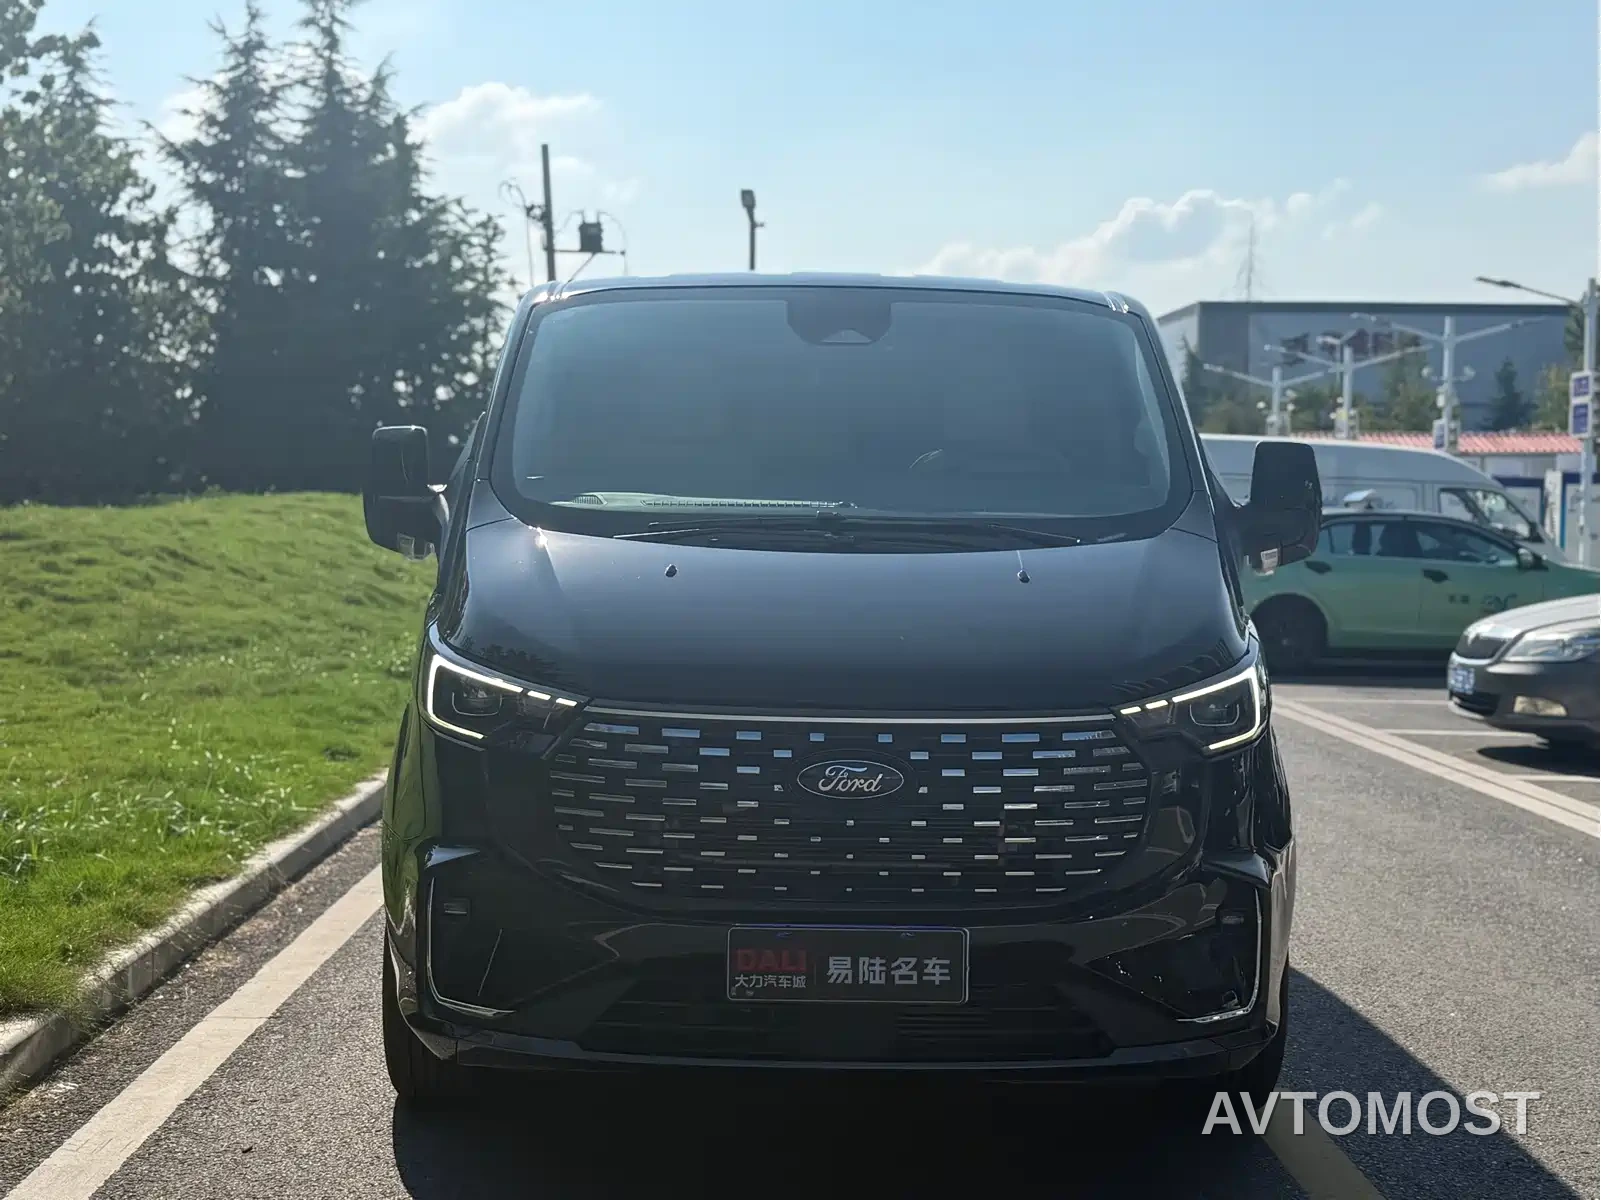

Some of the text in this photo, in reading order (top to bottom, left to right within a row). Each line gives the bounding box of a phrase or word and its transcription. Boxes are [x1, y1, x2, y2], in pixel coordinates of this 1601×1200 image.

[818, 765, 883, 792] Ford
[736, 948, 808, 972] DALI
[826, 956, 951, 986] 易陆名车
[734, 974, 807, 989] 大力汽车城
